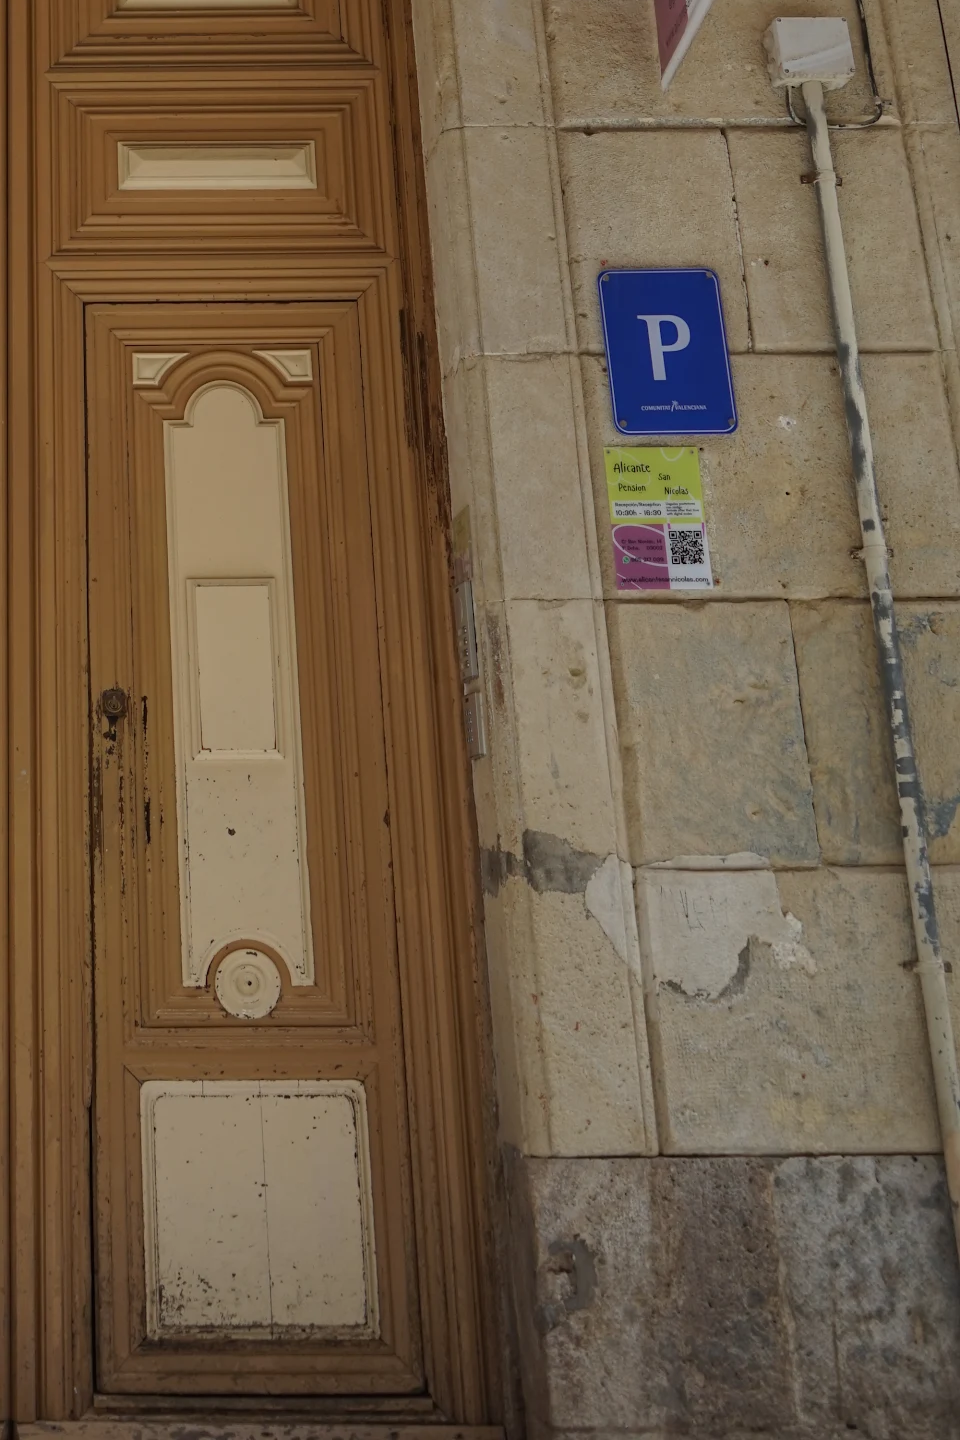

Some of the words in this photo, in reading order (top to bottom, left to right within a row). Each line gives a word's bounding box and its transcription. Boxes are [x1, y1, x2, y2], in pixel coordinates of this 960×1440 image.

[636, 314, 691, 381] P
[613, 461, 651, 474] Alicante
[658, 473, 671, 481] San
[618, 482, 647, 493] Pension
[664, 486, 689, 495] Nicolas
